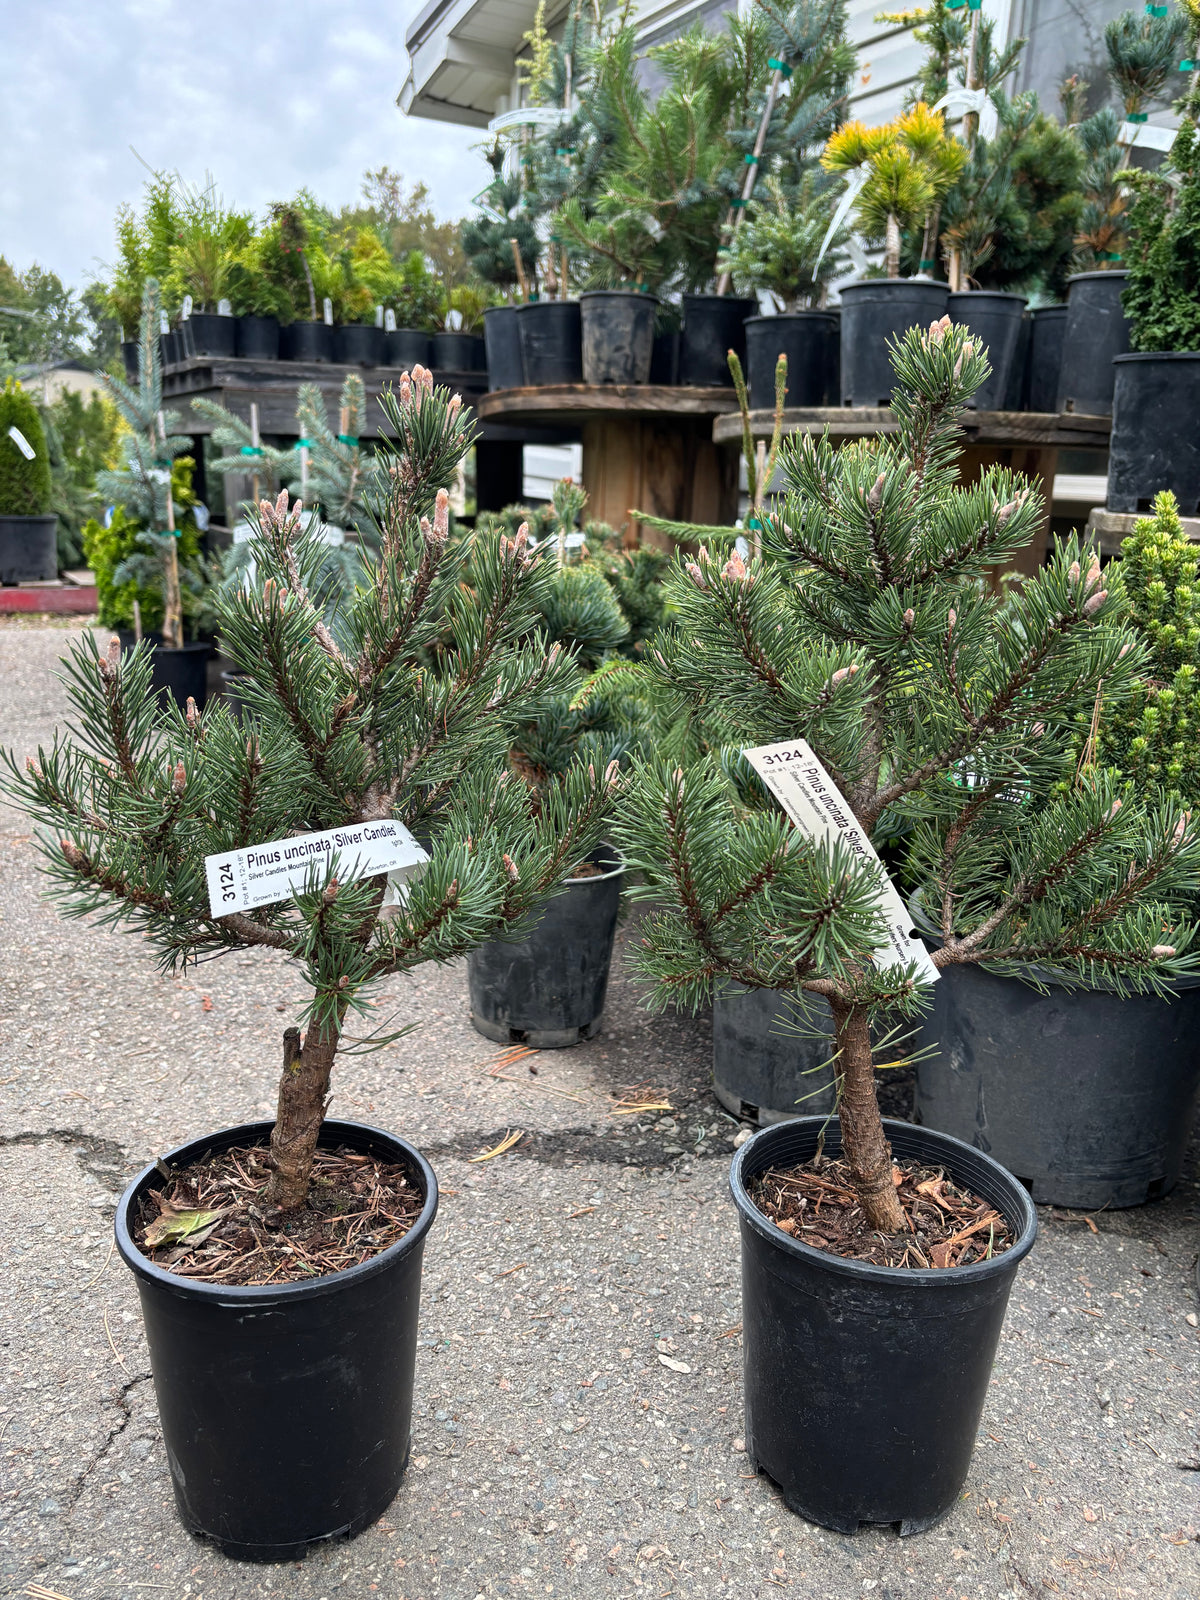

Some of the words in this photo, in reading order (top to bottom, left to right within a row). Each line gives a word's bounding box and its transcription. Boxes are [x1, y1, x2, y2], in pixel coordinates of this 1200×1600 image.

[762, 750, 803, 765] 3124
[801, 768, 826, 794] Pinus
[819, 793, 849, 829] uncinata
[843, 828, 865, 858] 'Silver
[808, 798, 822, 816] Mountain
[819, 814, 828, 824] Pine
[246, 852, 281, 868] Pinus
[284, 838, 332, 860] uncinata
[332, 832, 362, 848] 'Silver
[363, 824, 396, 841] Candles'
[218, 863, 236, 902] 3124
[248, 872, 264, 881] Silver
[264, 866, 286, 877] Candles
[896, 924, 906, 940] Grown
[895, 943, 907, 962] Nursery
